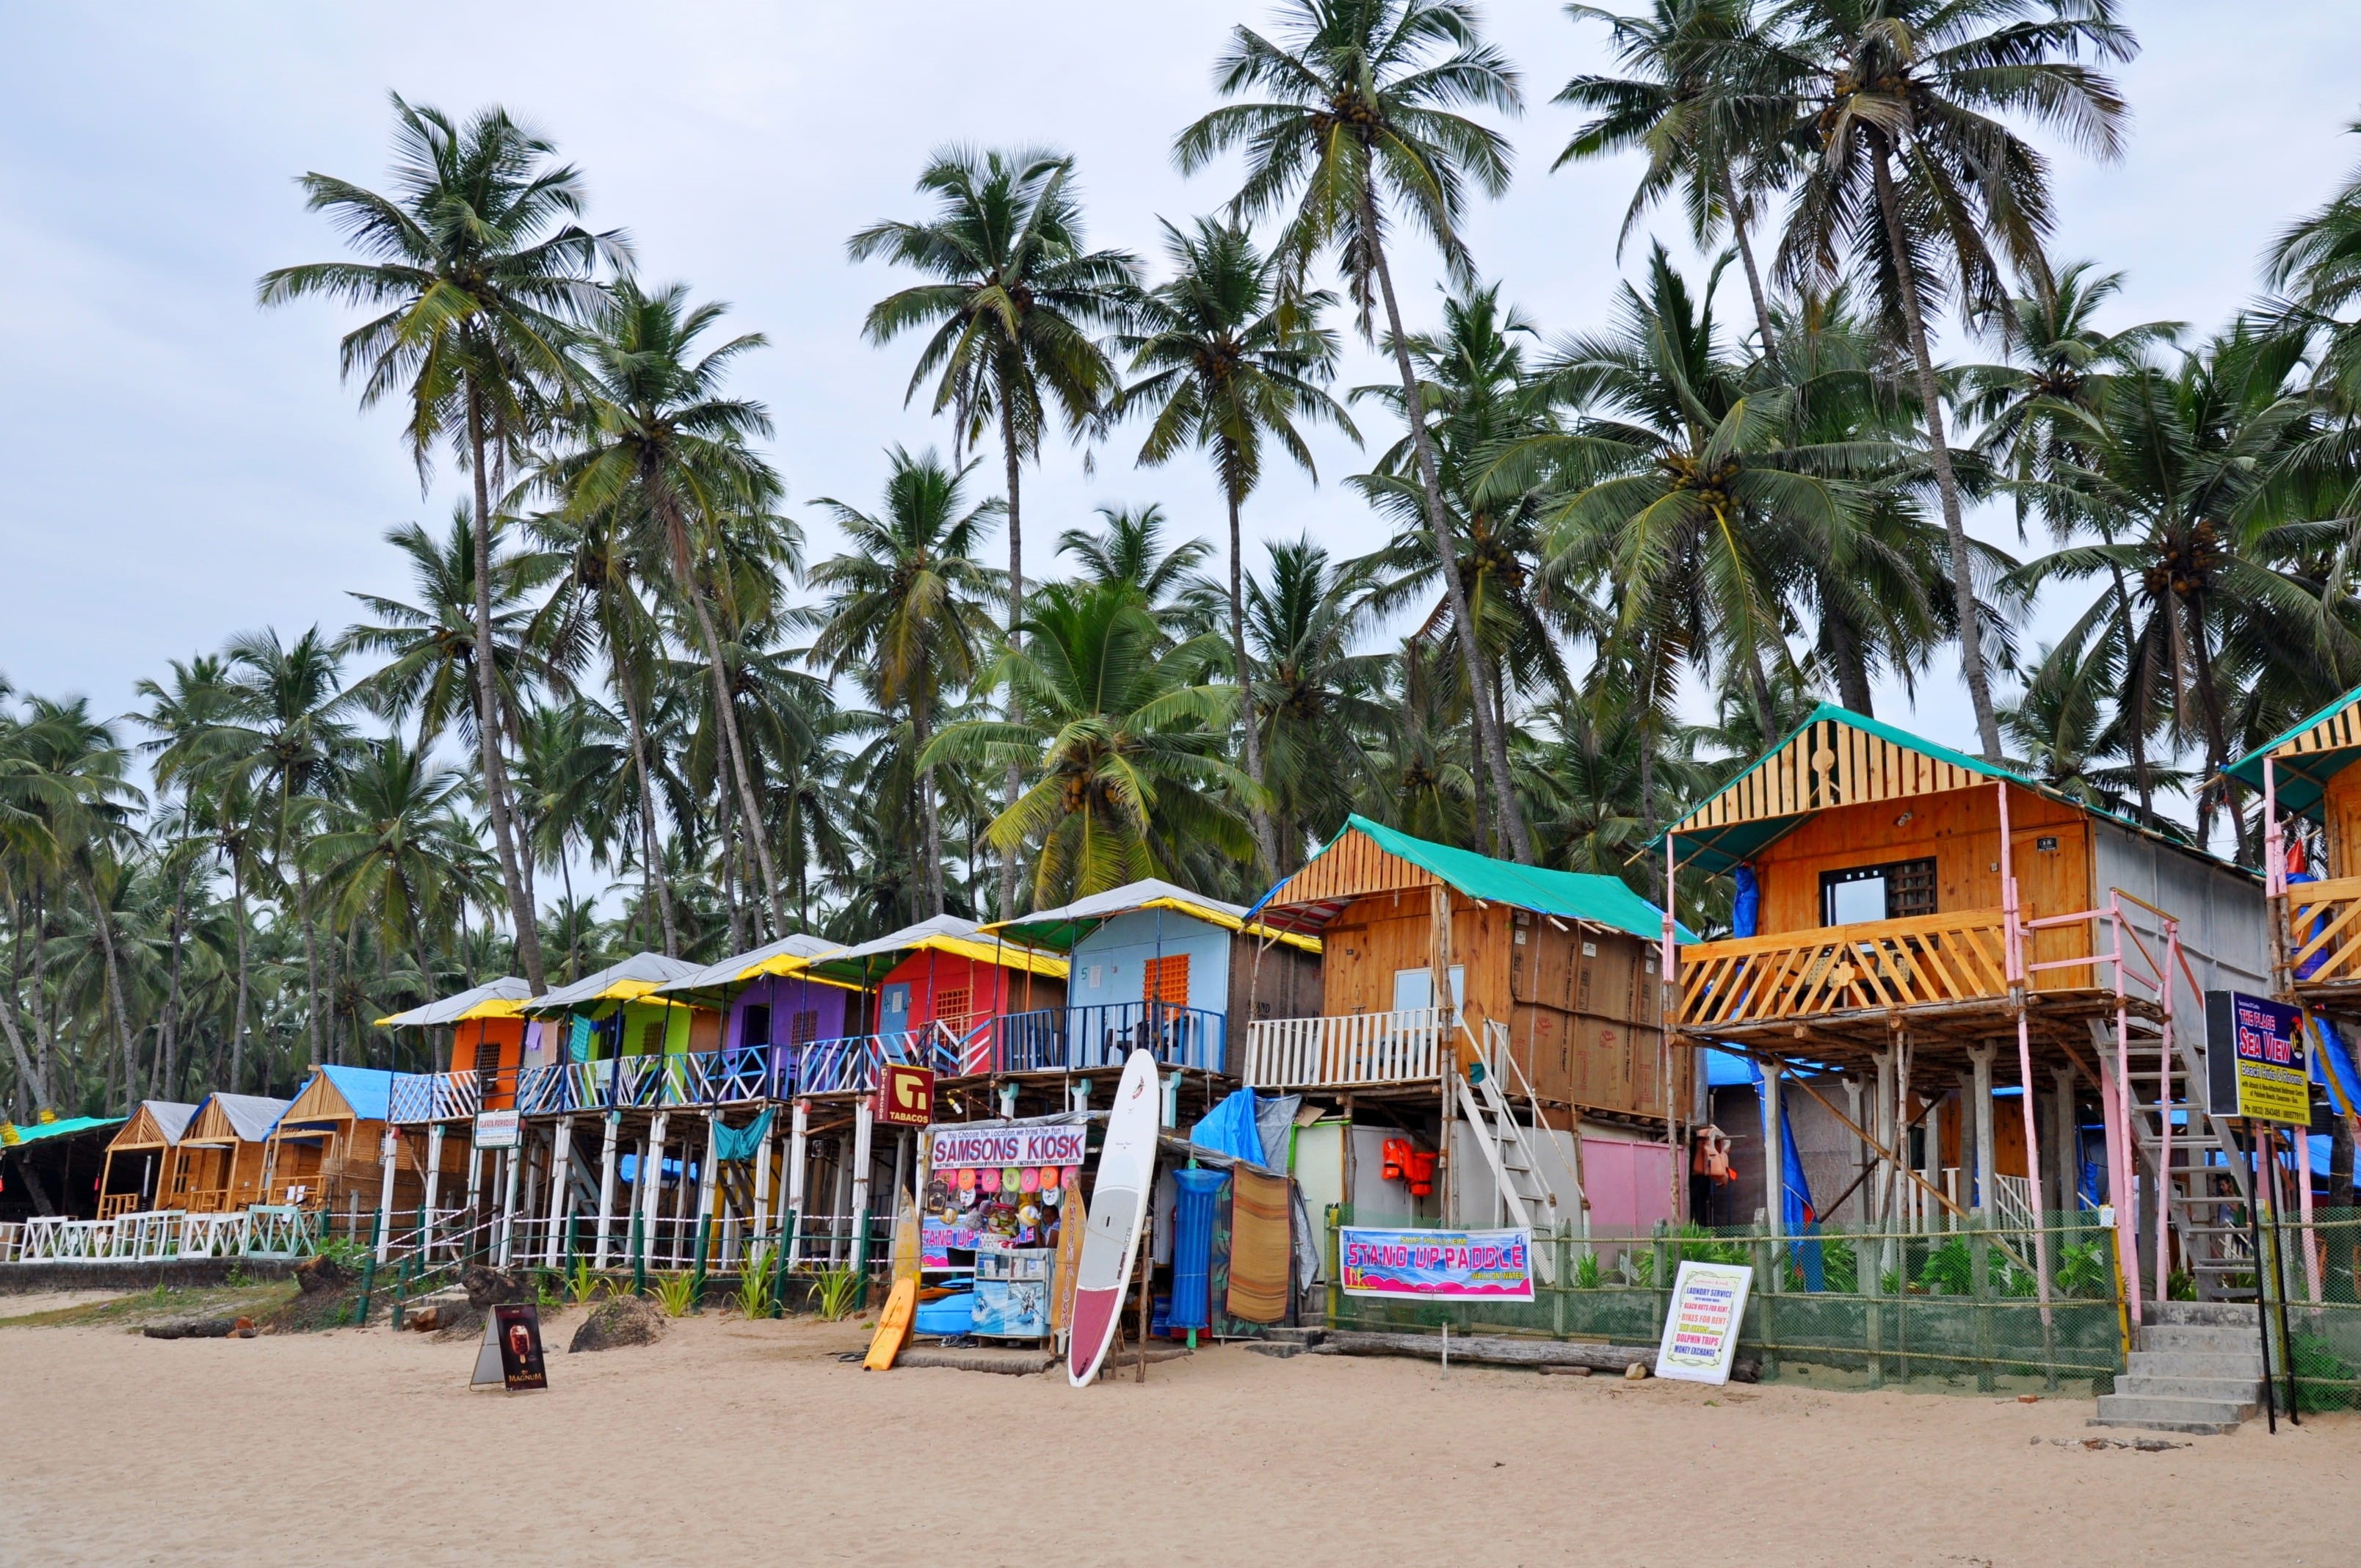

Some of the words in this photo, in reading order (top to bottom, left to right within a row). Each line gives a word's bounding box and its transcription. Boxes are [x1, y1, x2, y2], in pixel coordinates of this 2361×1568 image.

[1081, 967, 1088, 980] 5
[2239, 1009, 2254, 1026] THE
[2239, 1026, 2261, 1057] SEA
[2263, 1031, 2291, 1064] VIEW
[2241, 1062, 2260, 1079] Beach
[2261, 1066, 2276, 1081] Huts
[2277, 1069, 2282, 1082] &
[2282, 1070, 2304, 1086] Rooms
[890, 1111, 929, 1124] TABACOS
[958, 1130, 979, 1139] Choose
[981, 1129, 990, 1137] the
[1026, 1128, 1038, 1136] bring
[1051, 1127, 1062, 1135] fun
[935, 1137, 1019, 1162] SAMSONS
[1028, 1133, 1084, 1160] KIOSK
[957, 1230, 975, 1246] UP
[1400, 1236, 1421, 1244] SUP
[1348, 1242, 1409, 1268] STAND
[1414, 1246, 1440, 1269] UP
[1444, 1244, 1523, 1270] PADDLE
[1470, 1271, 1491, 1280] WALK
[1491, 1271, 1501, 1280] ON
[1501, 1271, 1524, 1280] WATER
[1686, 1287, 1710, 1296] LAUNDRY
[1711, 1289, 1733, 1299] SERVICE
[1681, 1313, 1698, 1322] BIKES
[1700, 1315, 1711, 1324] FOR
[1711, 1316, 1727, 1325] RENT
[1676, 1333, 1701, 1344] DOLPHIN
[1702, 1336, 1719, 1346] TRIPS
[1674, 1345, 1691, 1354] MONEY
[1691, 1346, 1716, 1357] EXCHANGE
[509, 1373, 542, 1382] MAGNUM
